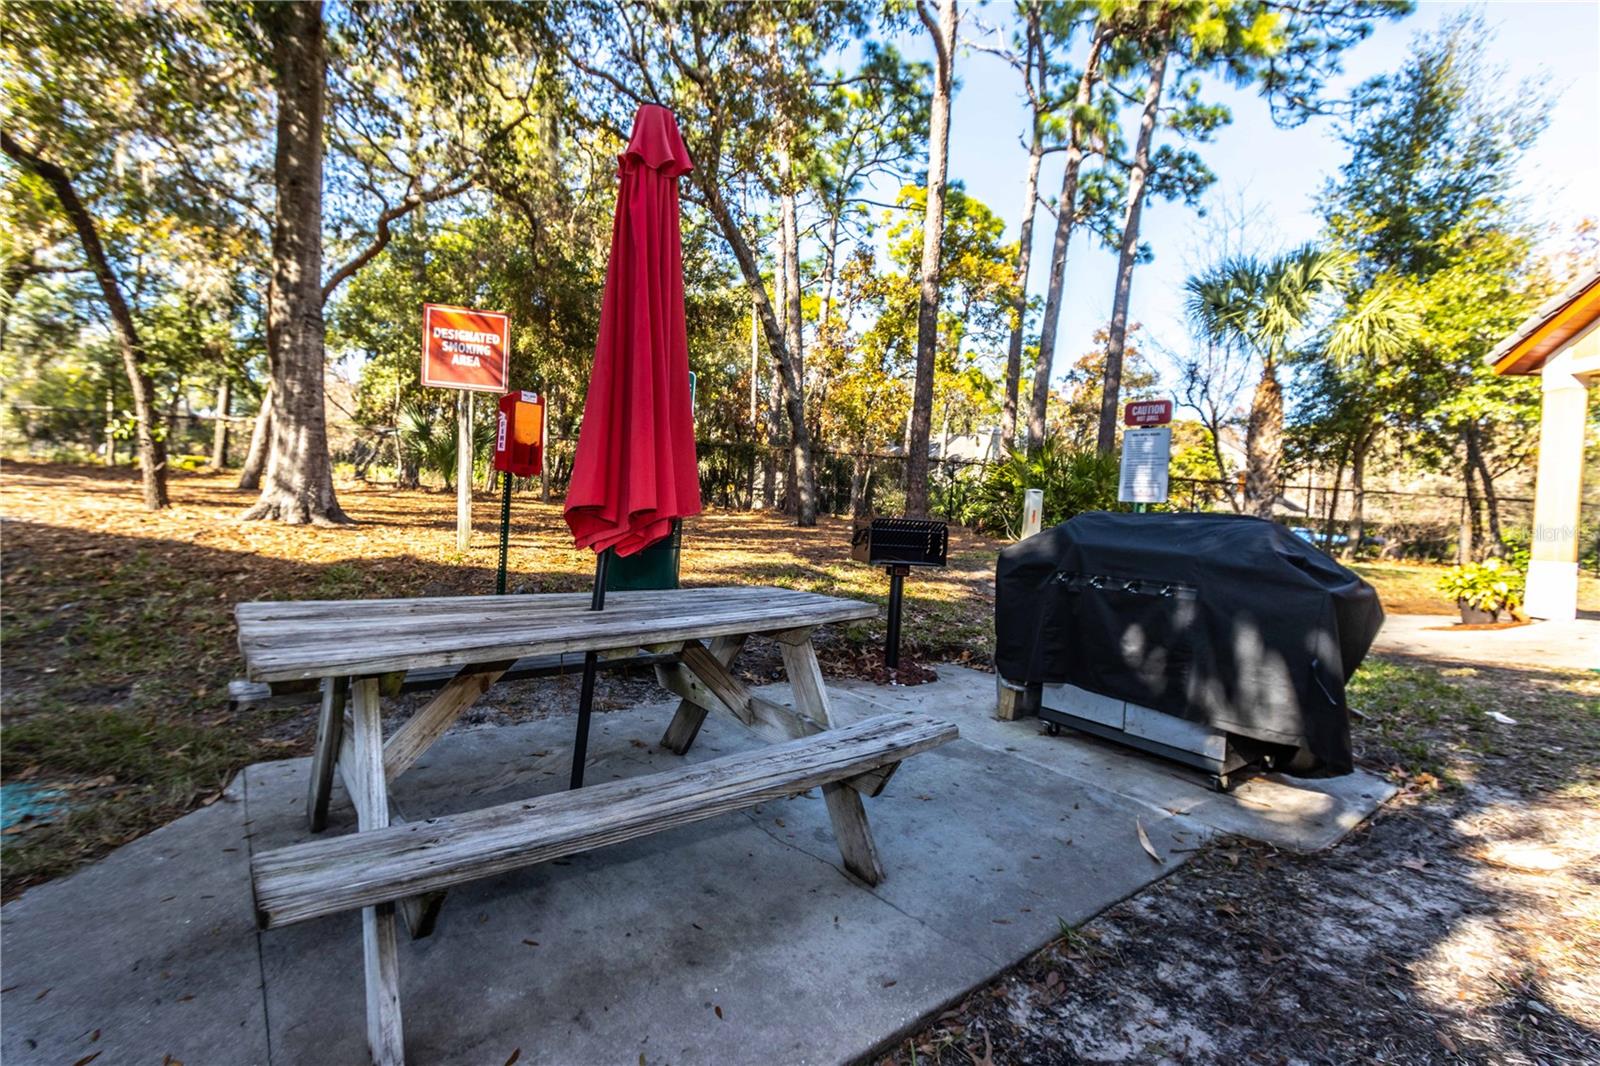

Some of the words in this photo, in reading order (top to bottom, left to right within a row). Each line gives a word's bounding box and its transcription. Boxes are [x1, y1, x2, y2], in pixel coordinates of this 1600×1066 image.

[432, 327, 500, 345] DESIGNATED
[442, 341, 491, 355] SMOKING
[451, 354, 481, 368] AREA
[1132, 404, 1165, 416] CAUTION
